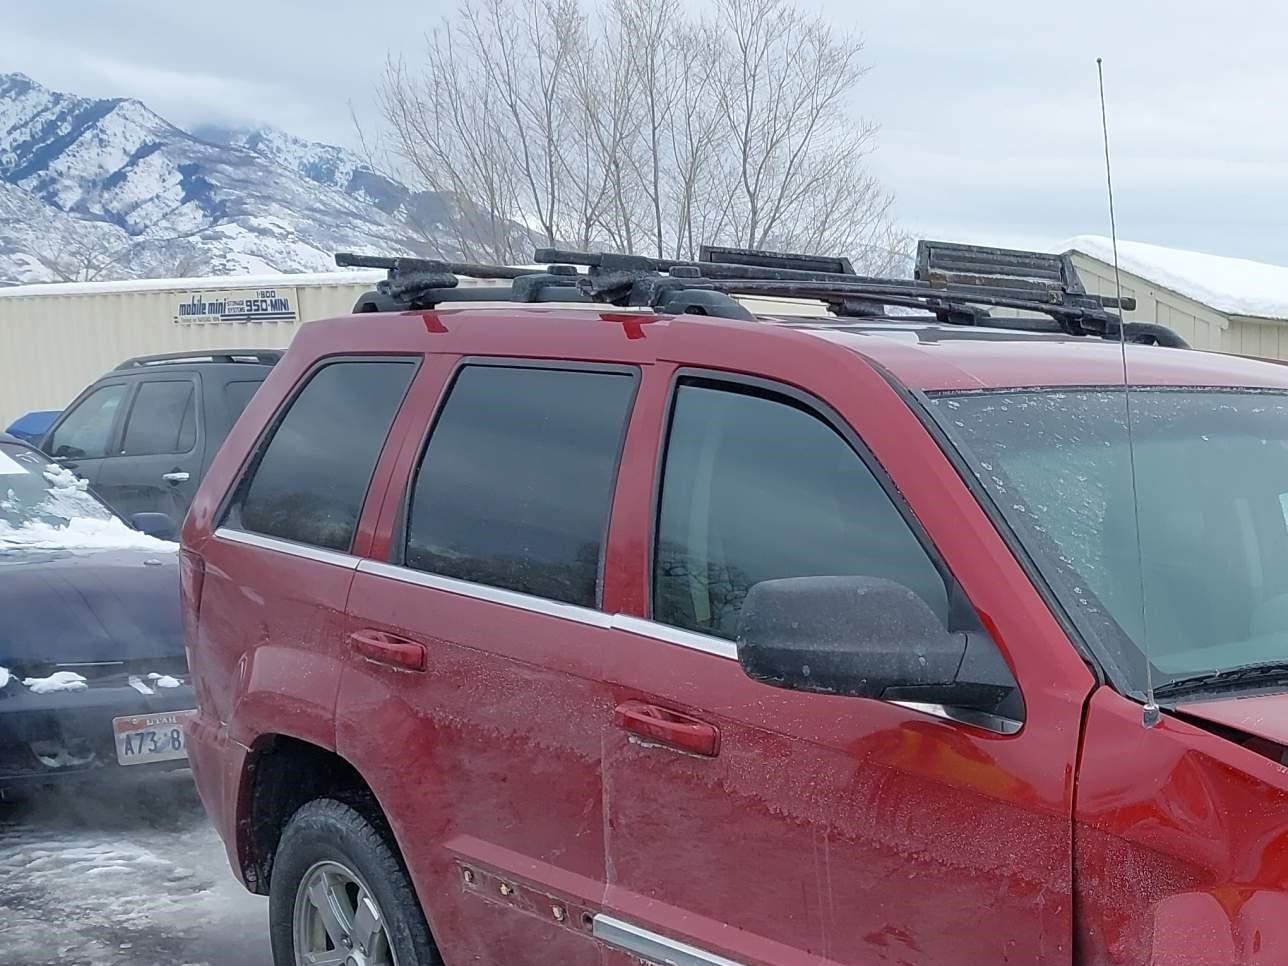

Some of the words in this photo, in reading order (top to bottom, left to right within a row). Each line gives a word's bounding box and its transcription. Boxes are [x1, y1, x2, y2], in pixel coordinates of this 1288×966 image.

[179, 295, 206, 316] mobile
[208, 298, 226, 314] mini
[146, 716, 177, 725] UTAH
